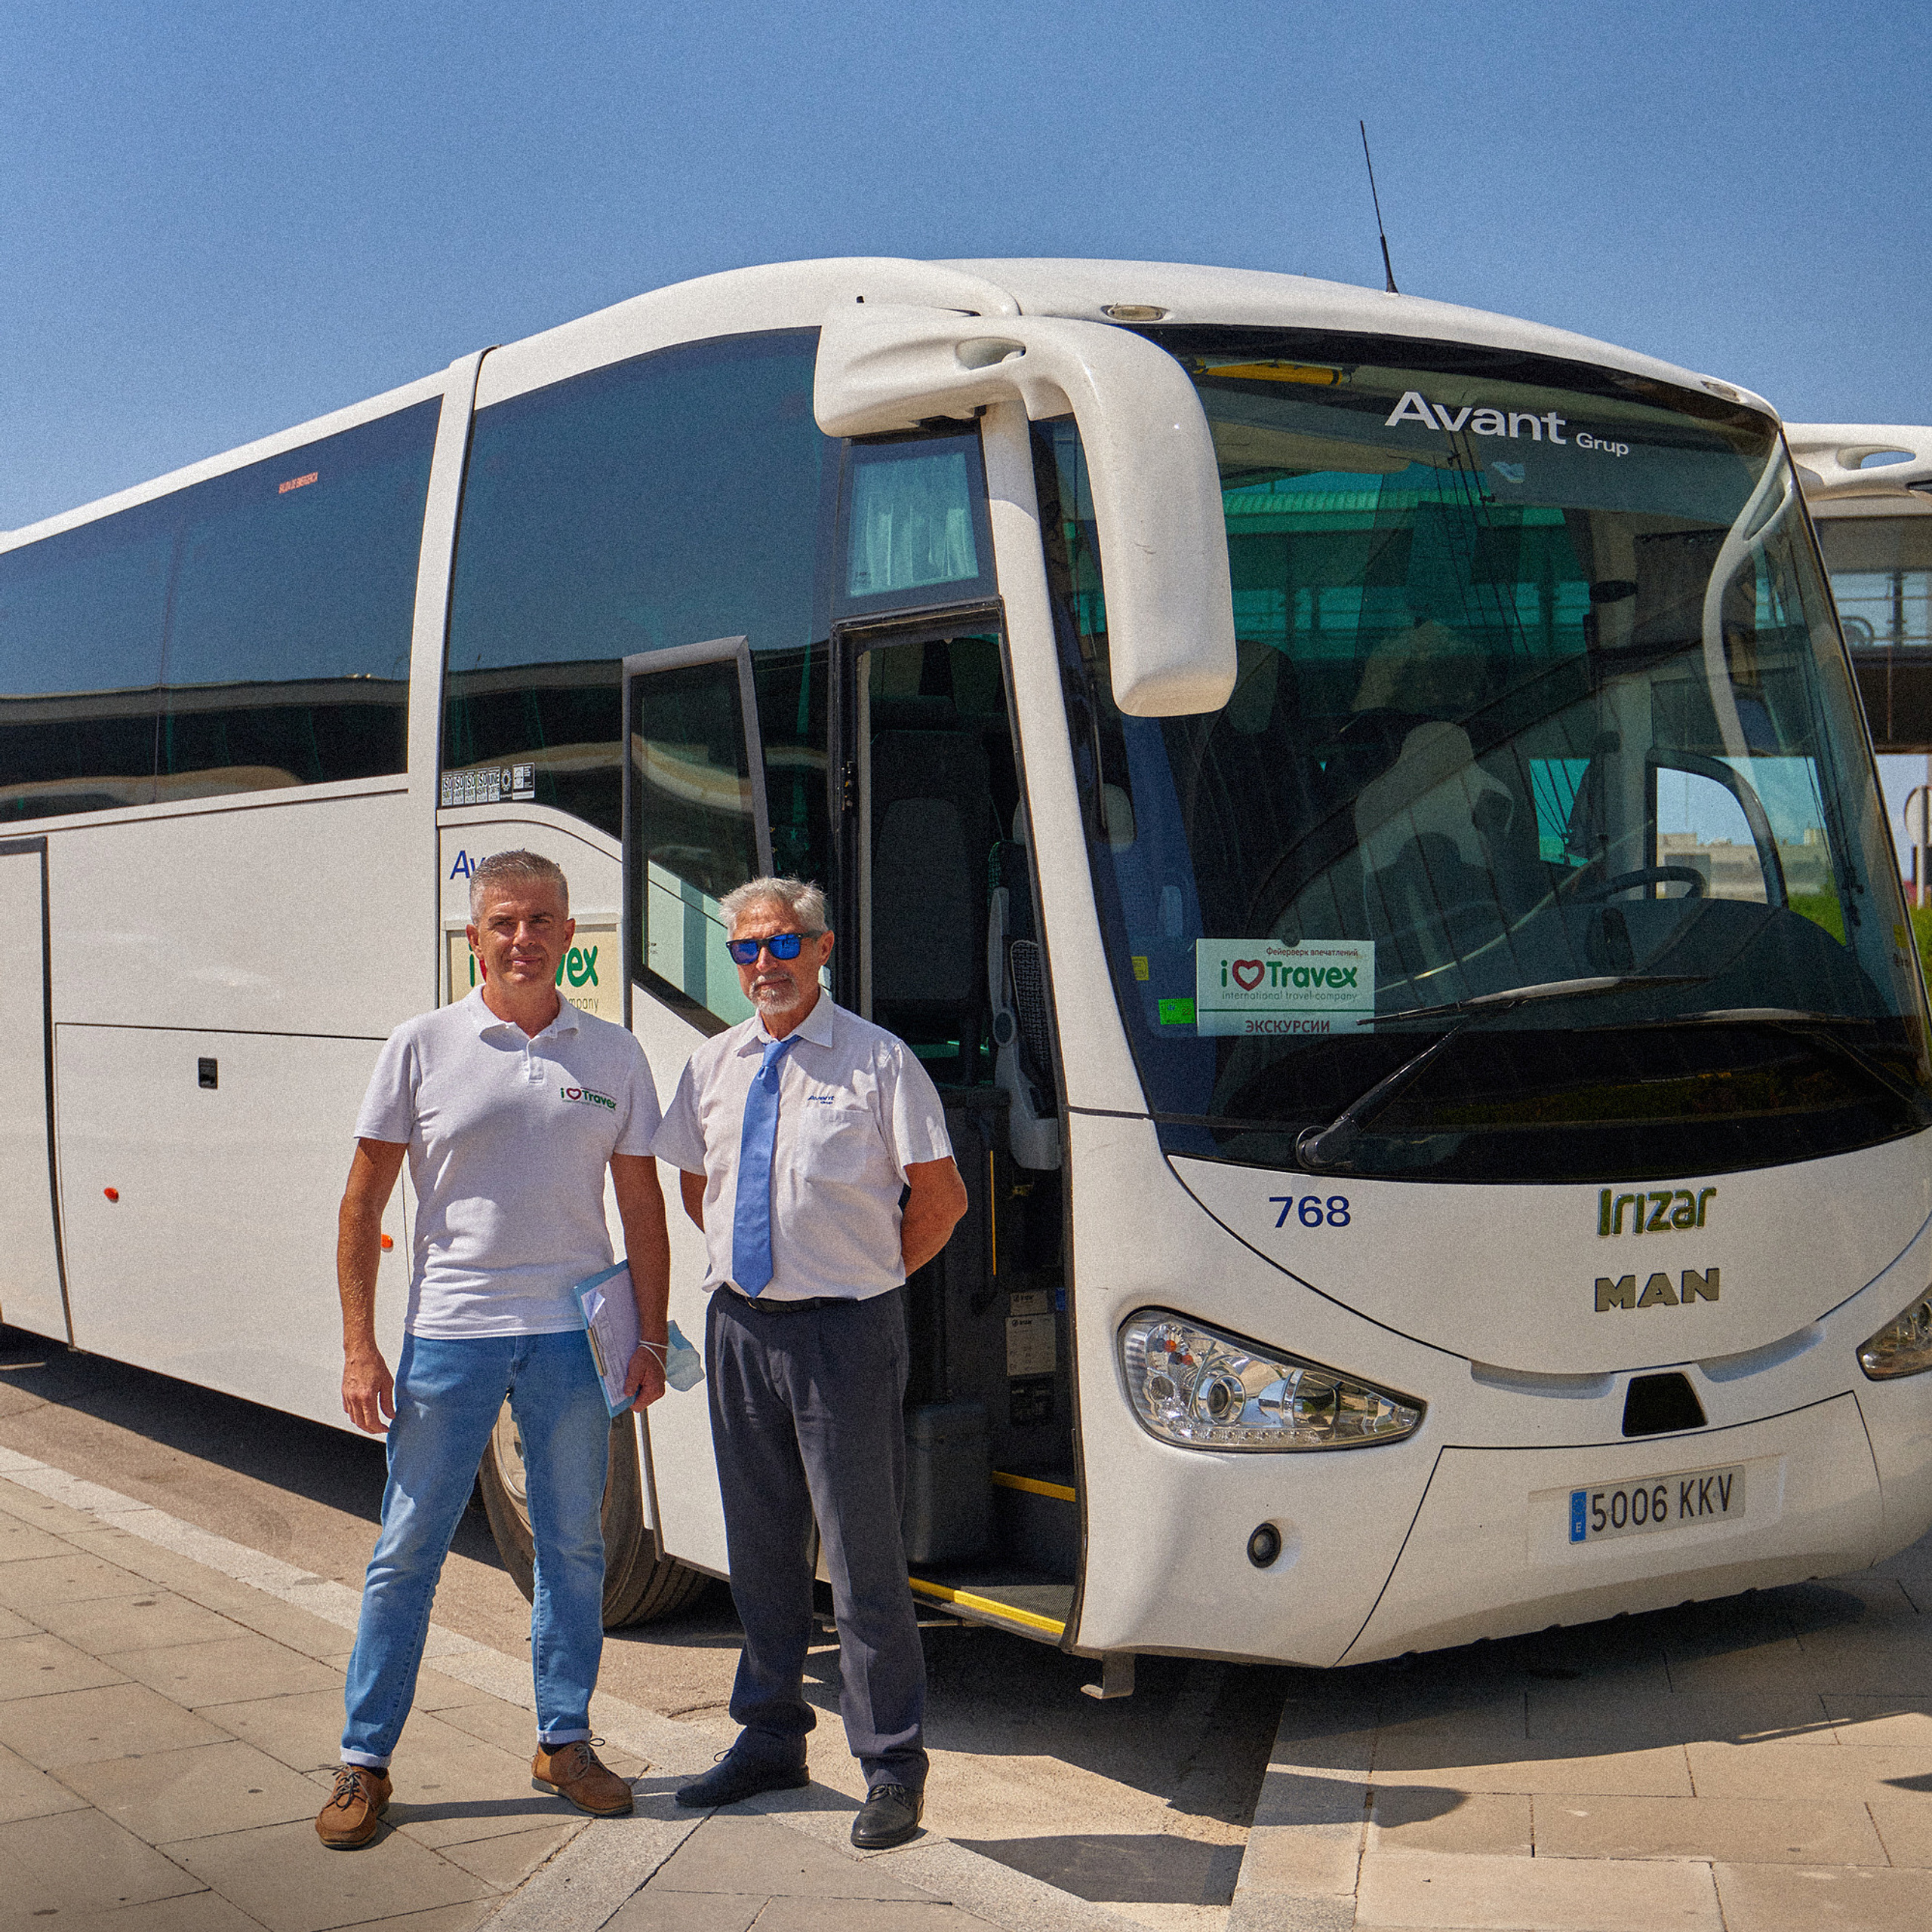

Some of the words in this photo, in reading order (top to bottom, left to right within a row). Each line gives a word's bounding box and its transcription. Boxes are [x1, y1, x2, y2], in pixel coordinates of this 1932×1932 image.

[1384, 391, 1567, 445] Avant
[1575, 432, 1629, 457] Grup
[1266, 946, 1309, 958] Фейерверк
[1310, 948, 1358, 956] впечатлений
[1266, 961, 1358, 988] Travex
[1222, 991, 1283, 1001] international
[1285, 991, 1312, 1000] travel
[1315, 992, 1357, 1002] company
[1245, 1020, 1331, 1033] ЭКСКУРСИИ
[581, 1090, 617, 1111] Travex
[1269, 1195, 1351, 1228] 768
[1597, 1186, 1717, 1238] Irizar
[1595, 1267, 1720, 1312] MAN
[1591, 1484, 1668, 1532] 5006
[1679, 1473, 1733, 1519] KKV
[1575, 1521, 1582, 1533] E
